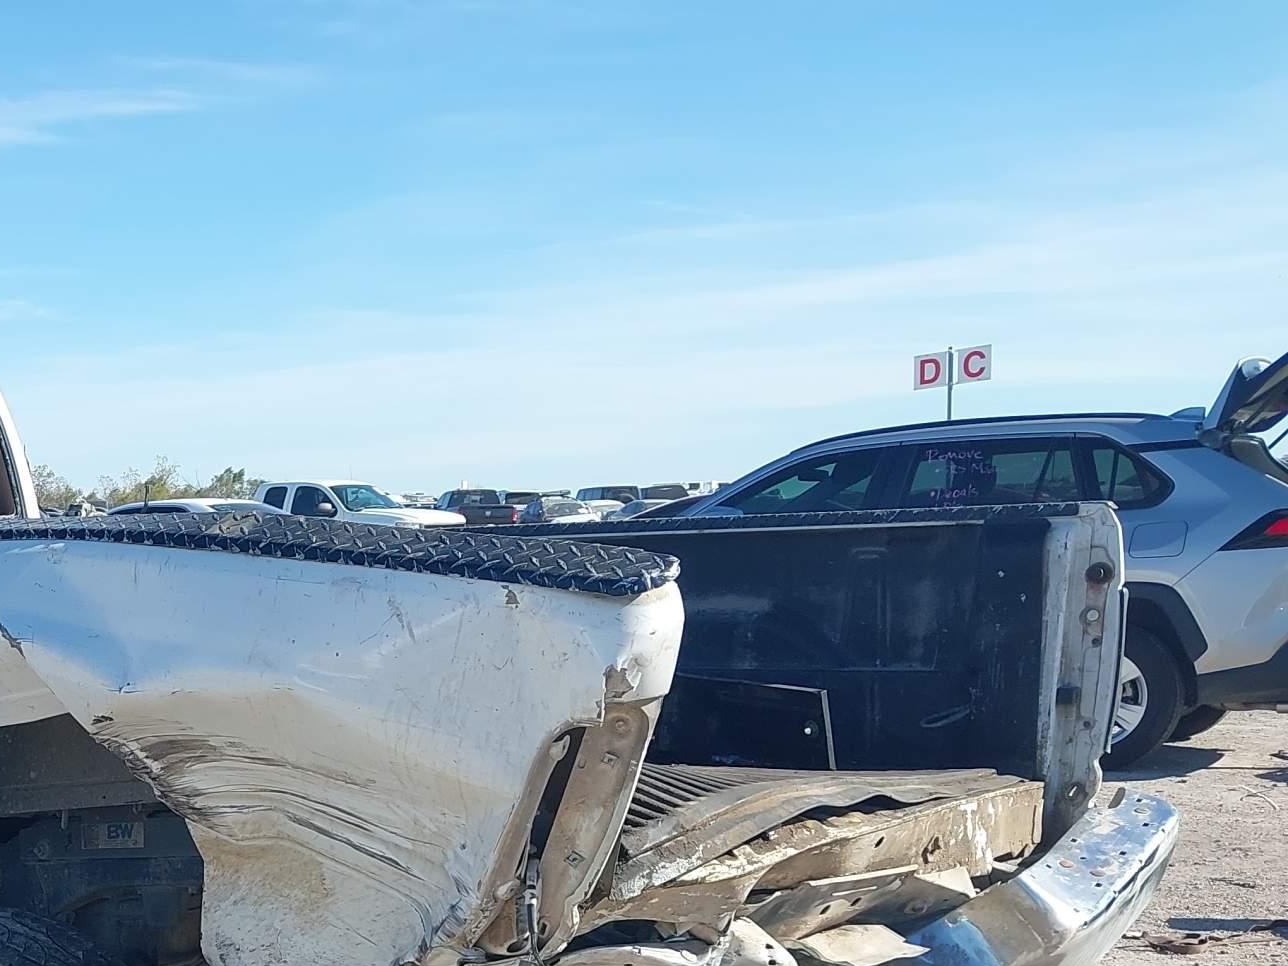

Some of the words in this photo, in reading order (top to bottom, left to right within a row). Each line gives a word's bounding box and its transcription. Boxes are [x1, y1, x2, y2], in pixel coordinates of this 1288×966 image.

[920, 358, 941, 385] D
[963, 350, 986, 378] C
[106, 823, 134, 839] BW
